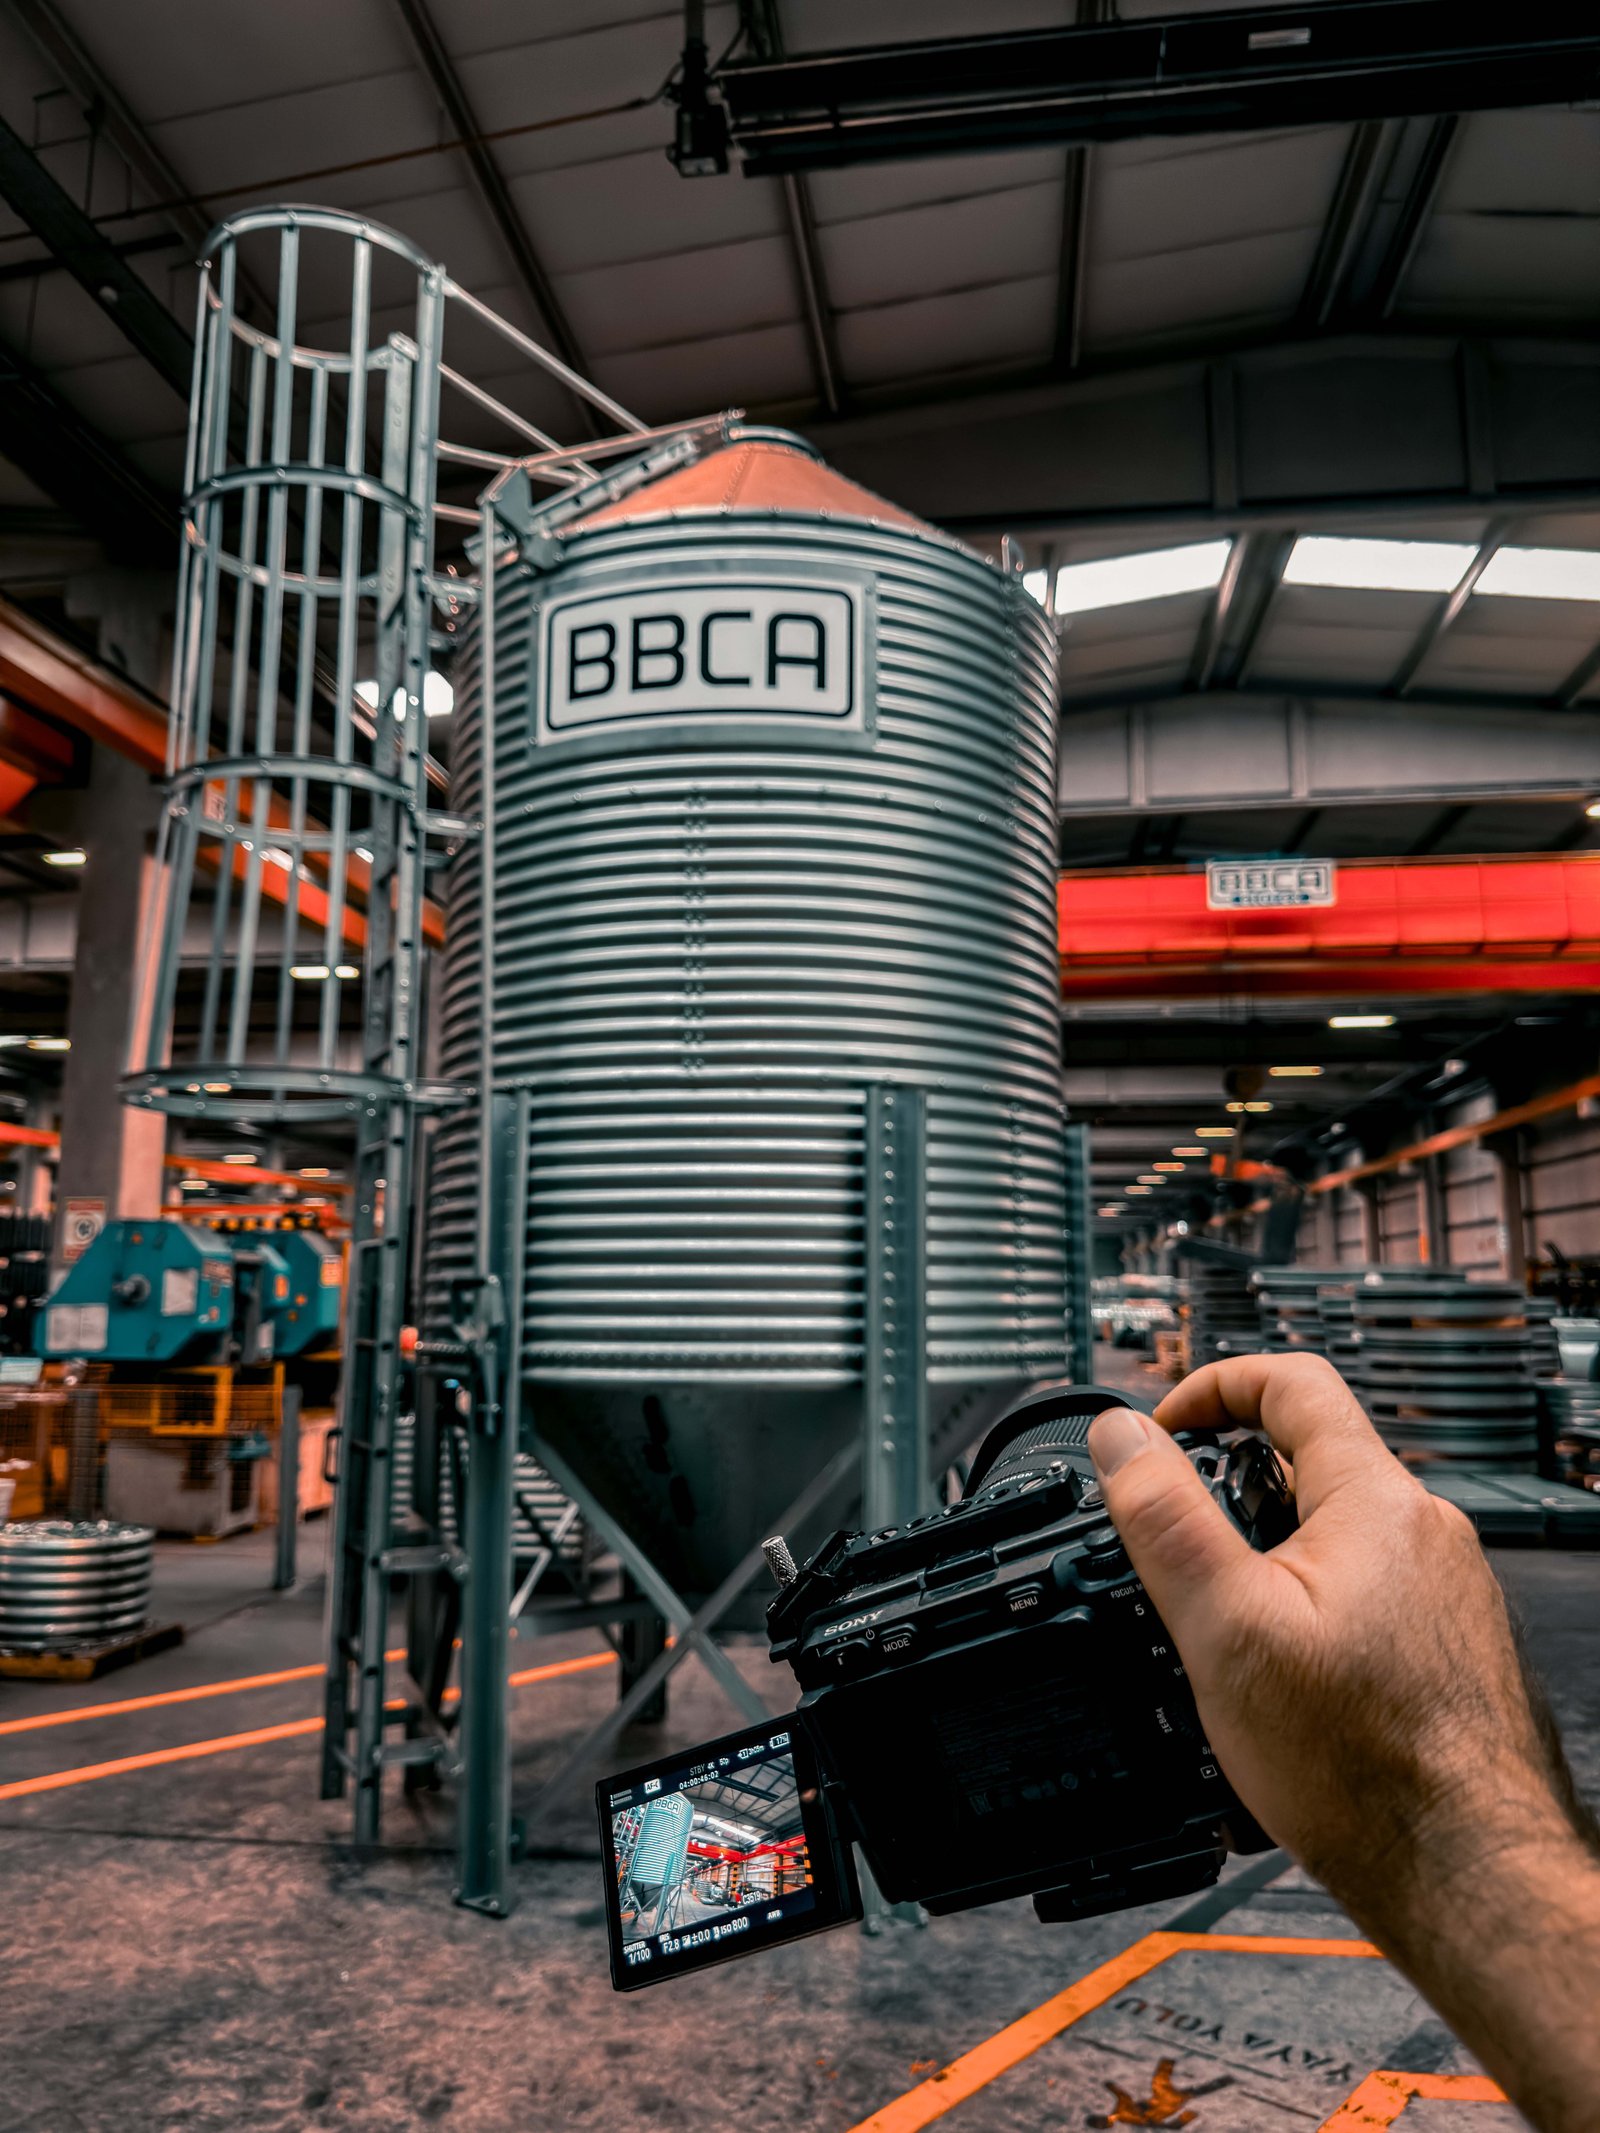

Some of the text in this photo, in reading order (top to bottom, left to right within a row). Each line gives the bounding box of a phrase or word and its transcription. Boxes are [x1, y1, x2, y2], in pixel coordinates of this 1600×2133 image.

[568, 610, 826, 702] BBCA
[1110, 1585, 1135, 1599] FOCUS
[1010, 1595, 1038, 1612] MENU
[1134, 1603, 1145, 1616] 5
[824, 1609, 883, 1637] SONY
[883, 1637, 910, 1653] MODE
[1151, 1646, 1166, 1657] Fn
[689, 1763, 705, 1776] STBY
[655, 1799, 679, 1814] BBCA
[663, 1938, 680, 1954] F2.8
[628, 1947, 651, 1966] 1/100
[1114, 1997, 1224, 2042] YOLU
